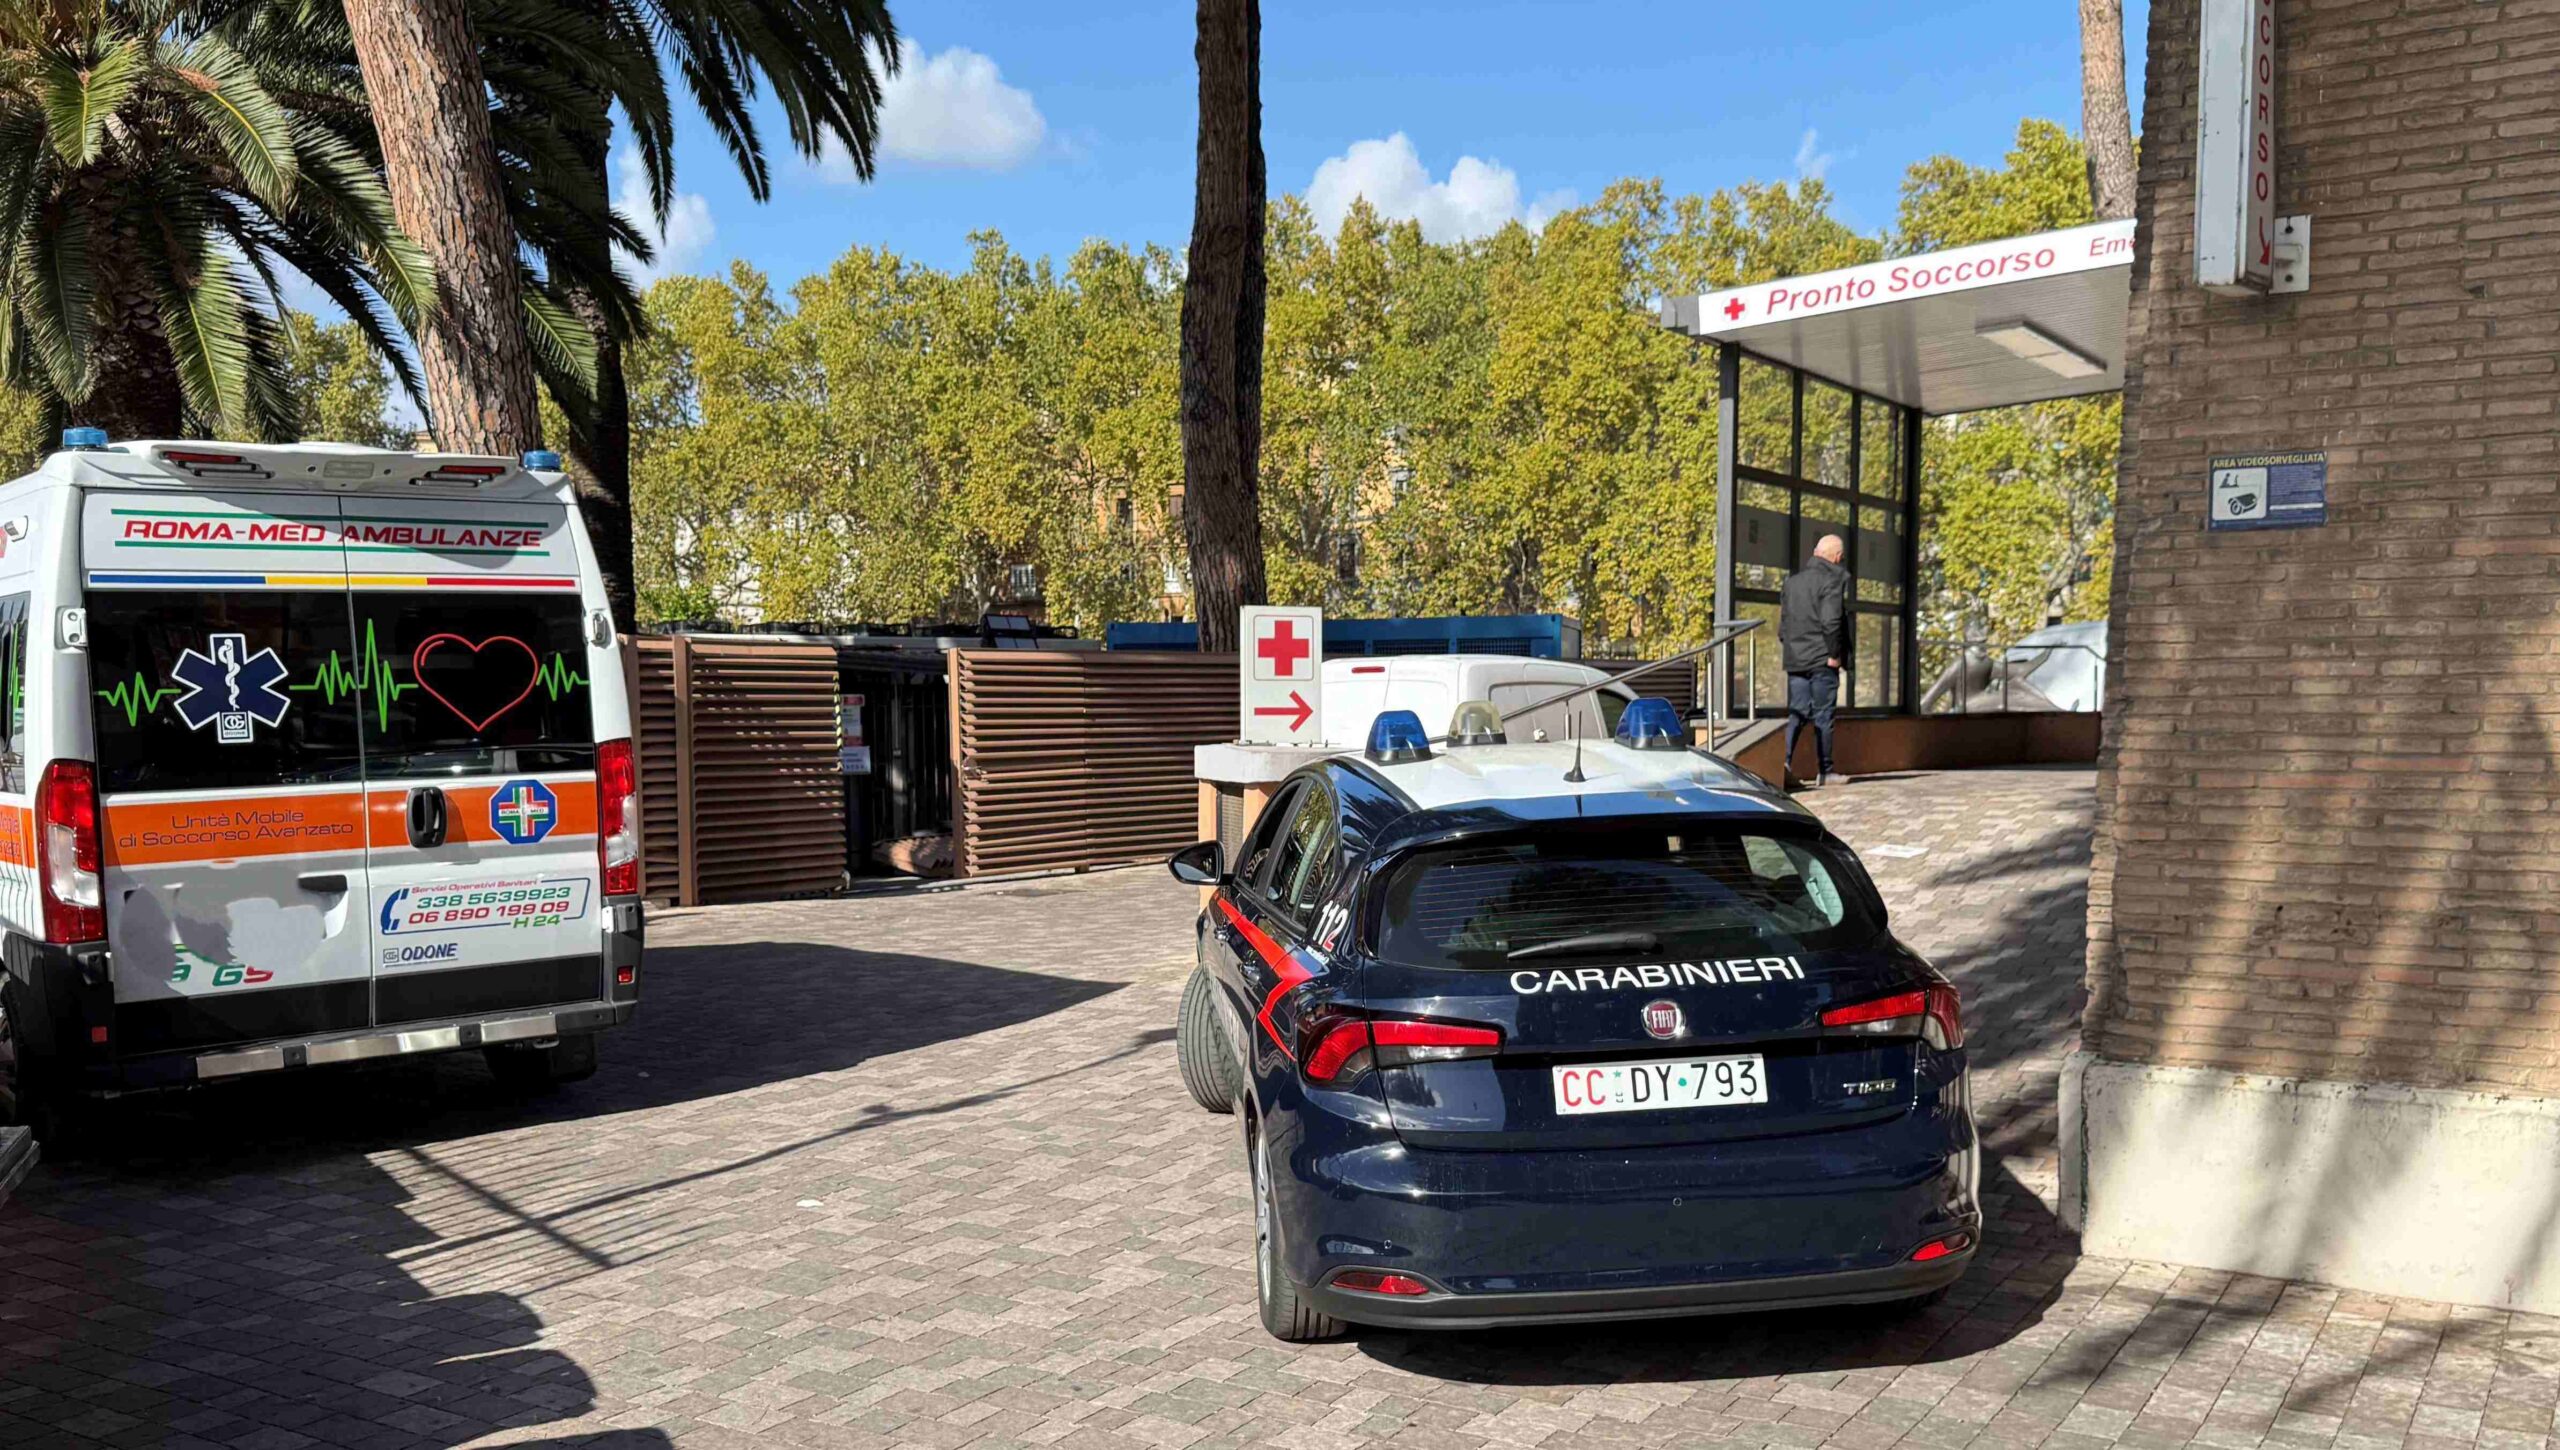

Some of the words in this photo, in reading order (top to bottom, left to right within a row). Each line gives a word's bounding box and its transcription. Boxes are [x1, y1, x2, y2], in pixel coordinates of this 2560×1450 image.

[2255, 0, 2271, 201] CORSO
[1766, 276, 1876, 315] Pronto
[1887, 246, 2056, 294] Soccorso
[2212, 459, 2236, 468] AREA
[124, 519, 325, 543] ROMA-MED
[338, 525, 543, 547] AMBULANZE
[172, 813, 230, 829] Unità
[236, 810, 304, 826] Mobile
[119, 834, 137, 848] di
[143, 829, 250, 847] Soccorso
[256, 823, 354, 839] Avanzato
[411, 884, 447, 894] Servizi
[448, 882, 496, 892] Operativi
[497, 879, 538, 888] Sanitari
[417, 895, 462, 909] 338
[468, 887, 571, 905] 5639923
[408, 911, 439, 925] 06
[445, 907, 489, 922] 890
[497, 903, 536, 917] 199
[541, 900, 570, 914] 09
[513, 917, 529, 929] H
[533, 914, 560, 927] 24
[1312, 900, 1349, 952] 112
[401, 943, 458, 961] ODONE
[1510, 956, 1805, 994] CARABINIERI
[1652, 1009, 1675, 1028] FIAT
[1562, 1069, 1606, 1107] CC
[1631, 1065, 1671, 1103] DY
[1691, 1060, 1758, 1100] 793
